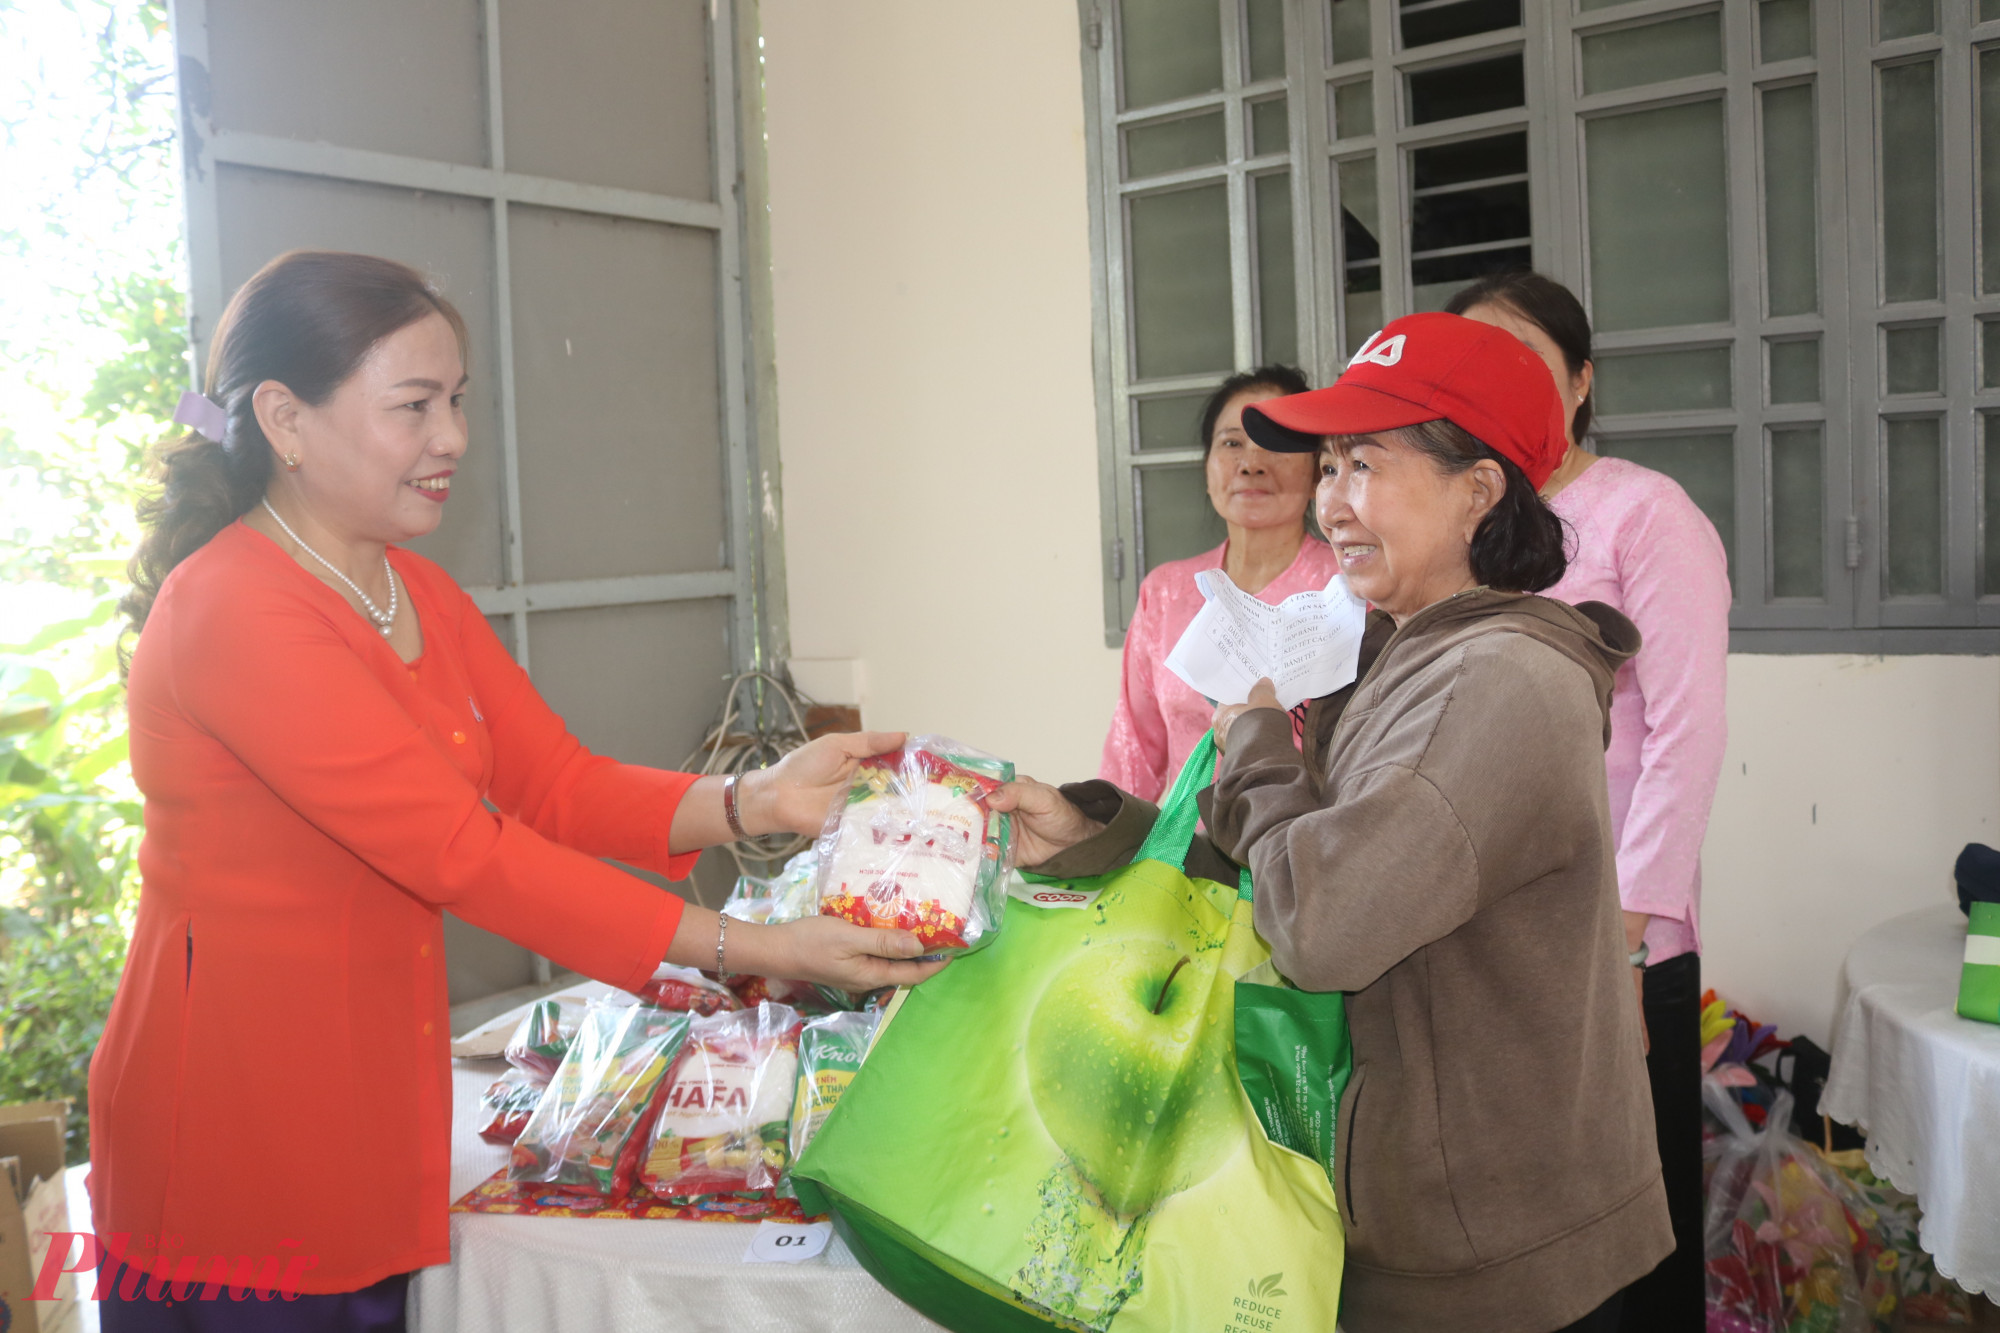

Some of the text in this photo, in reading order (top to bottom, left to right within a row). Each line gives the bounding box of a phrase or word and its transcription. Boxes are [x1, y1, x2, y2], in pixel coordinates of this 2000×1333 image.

[814, 1044, 864, 1064] Kno
[775, 1235, 806, 1247] 01
[1233, 1297, 1282, 1319] REDUCE
[1235, 1312, 1273, 1332] REUSE
